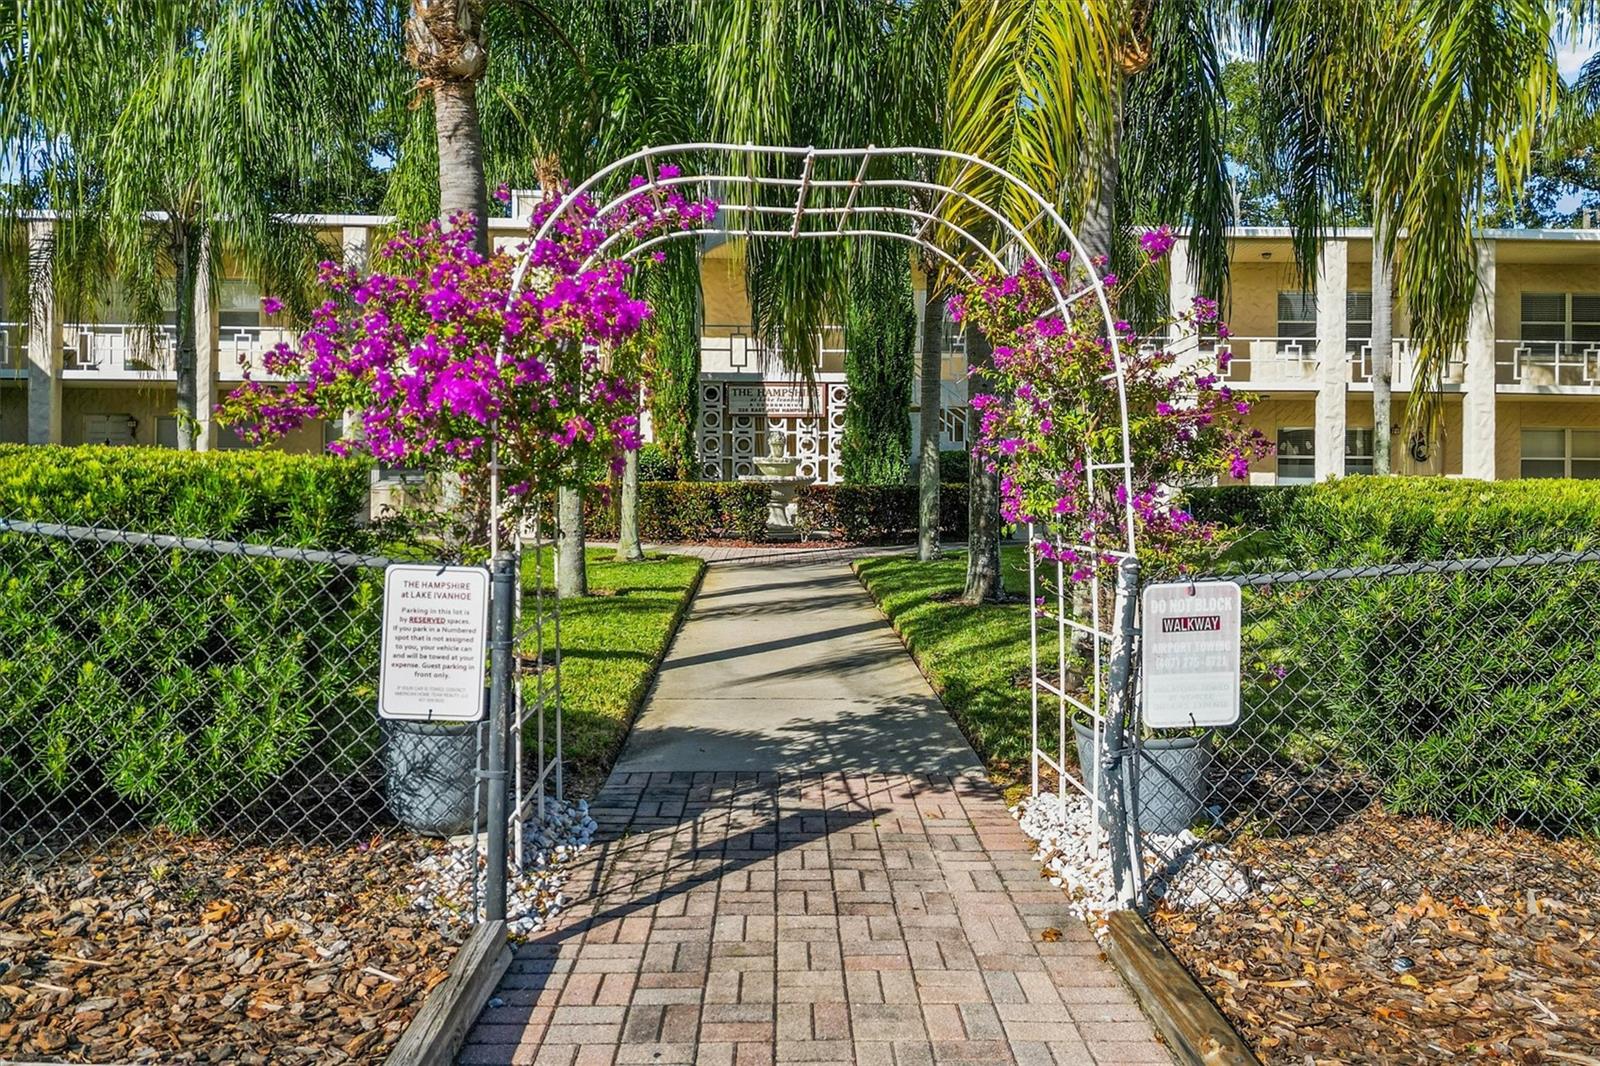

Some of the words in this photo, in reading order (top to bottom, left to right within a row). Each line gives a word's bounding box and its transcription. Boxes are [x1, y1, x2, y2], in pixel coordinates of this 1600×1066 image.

[732, 388, 753, 396] THE
[421, 581, 471, 590] HAMPSHIRE
[1151, 599, 1166, 614] DO
[1169, 598, 1193, 613] NOT
[1195, 597, 1232, 612] BLOCK
[401, 607, 429, 615] Parking
[1164, 617, 1218, 631] WALKWAY
[446, 636, 474, 644] assigned
[1152, 642, 1193, 654] AIRPORT
[442, 663, 467, 671] parking
